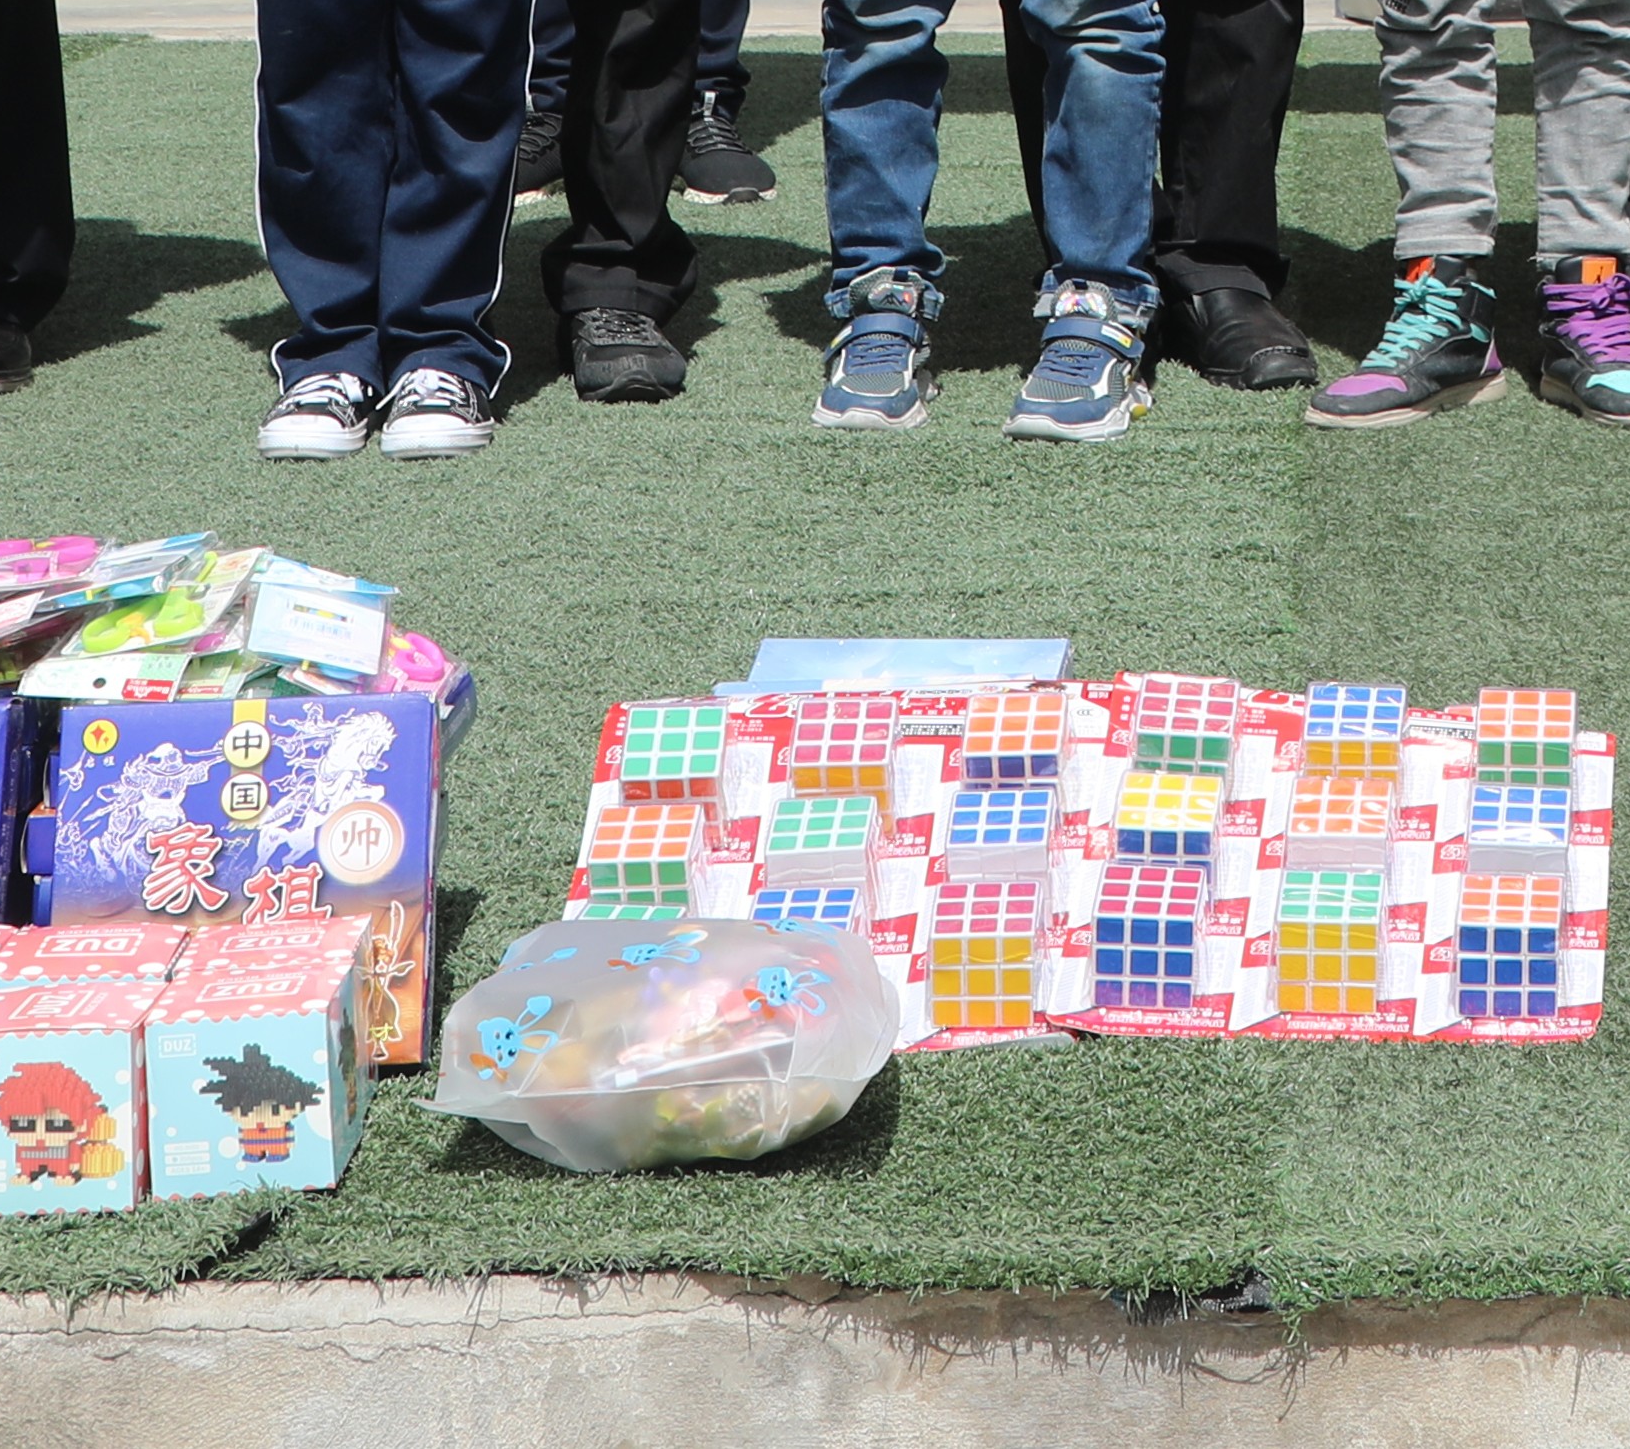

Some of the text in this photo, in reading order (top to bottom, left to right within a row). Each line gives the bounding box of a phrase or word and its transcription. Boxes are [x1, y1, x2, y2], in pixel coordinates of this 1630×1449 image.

[229, 729, 263, 813] 中国
[342, 817, 381, 867] 帅
[141, 821, 334, 925] 象棋
[51, 936, 128, 954] DUZ
[239, 935, 312, 951] DUZ
[216, 980, 293, 997] DUZ
[164, 1038, 192, 1053] DUZ
